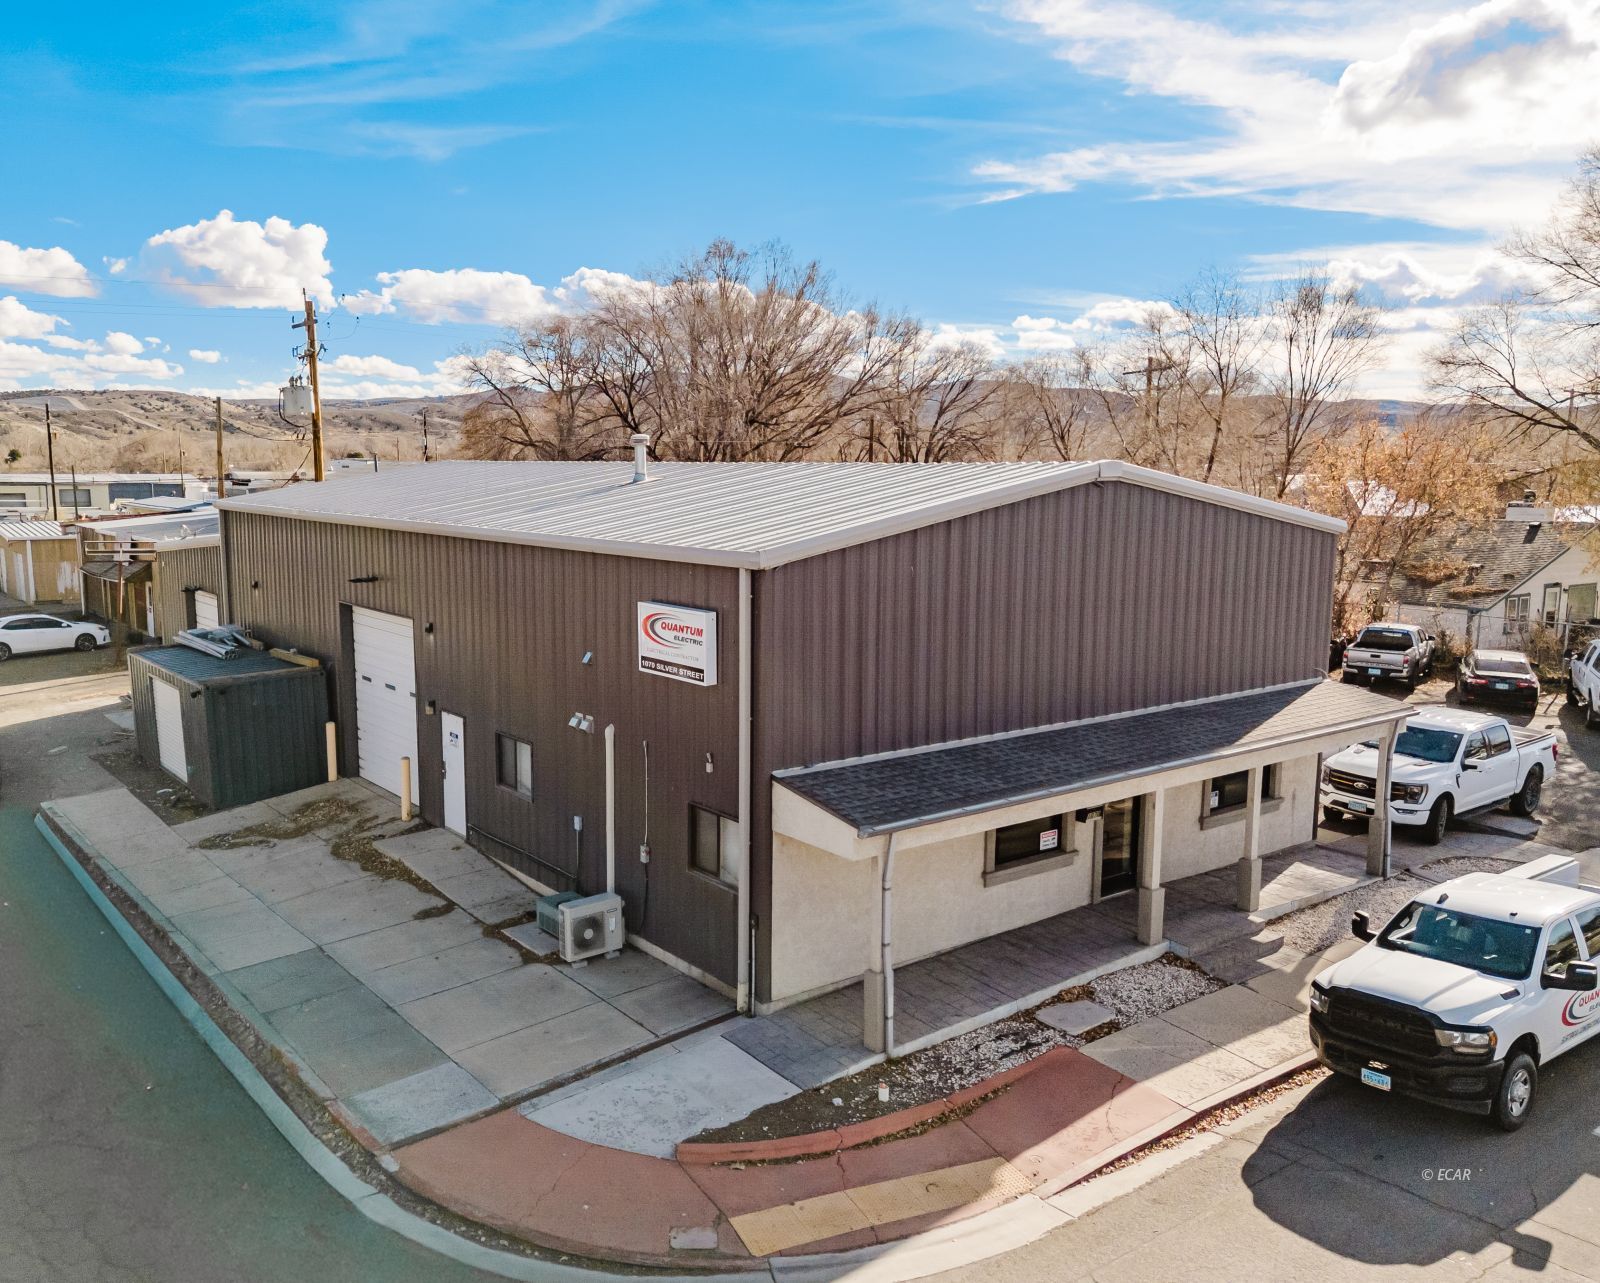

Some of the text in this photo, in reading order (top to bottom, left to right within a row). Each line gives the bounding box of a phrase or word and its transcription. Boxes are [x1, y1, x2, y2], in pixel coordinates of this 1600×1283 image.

[660, 621, 704, 637] QUANTUM
[674, 635, 703, 646] ELECTRIC
[641, 660, 704, 680] 1070 SILVER STREET
[1579, 989, 1600, 1008] QUAN
